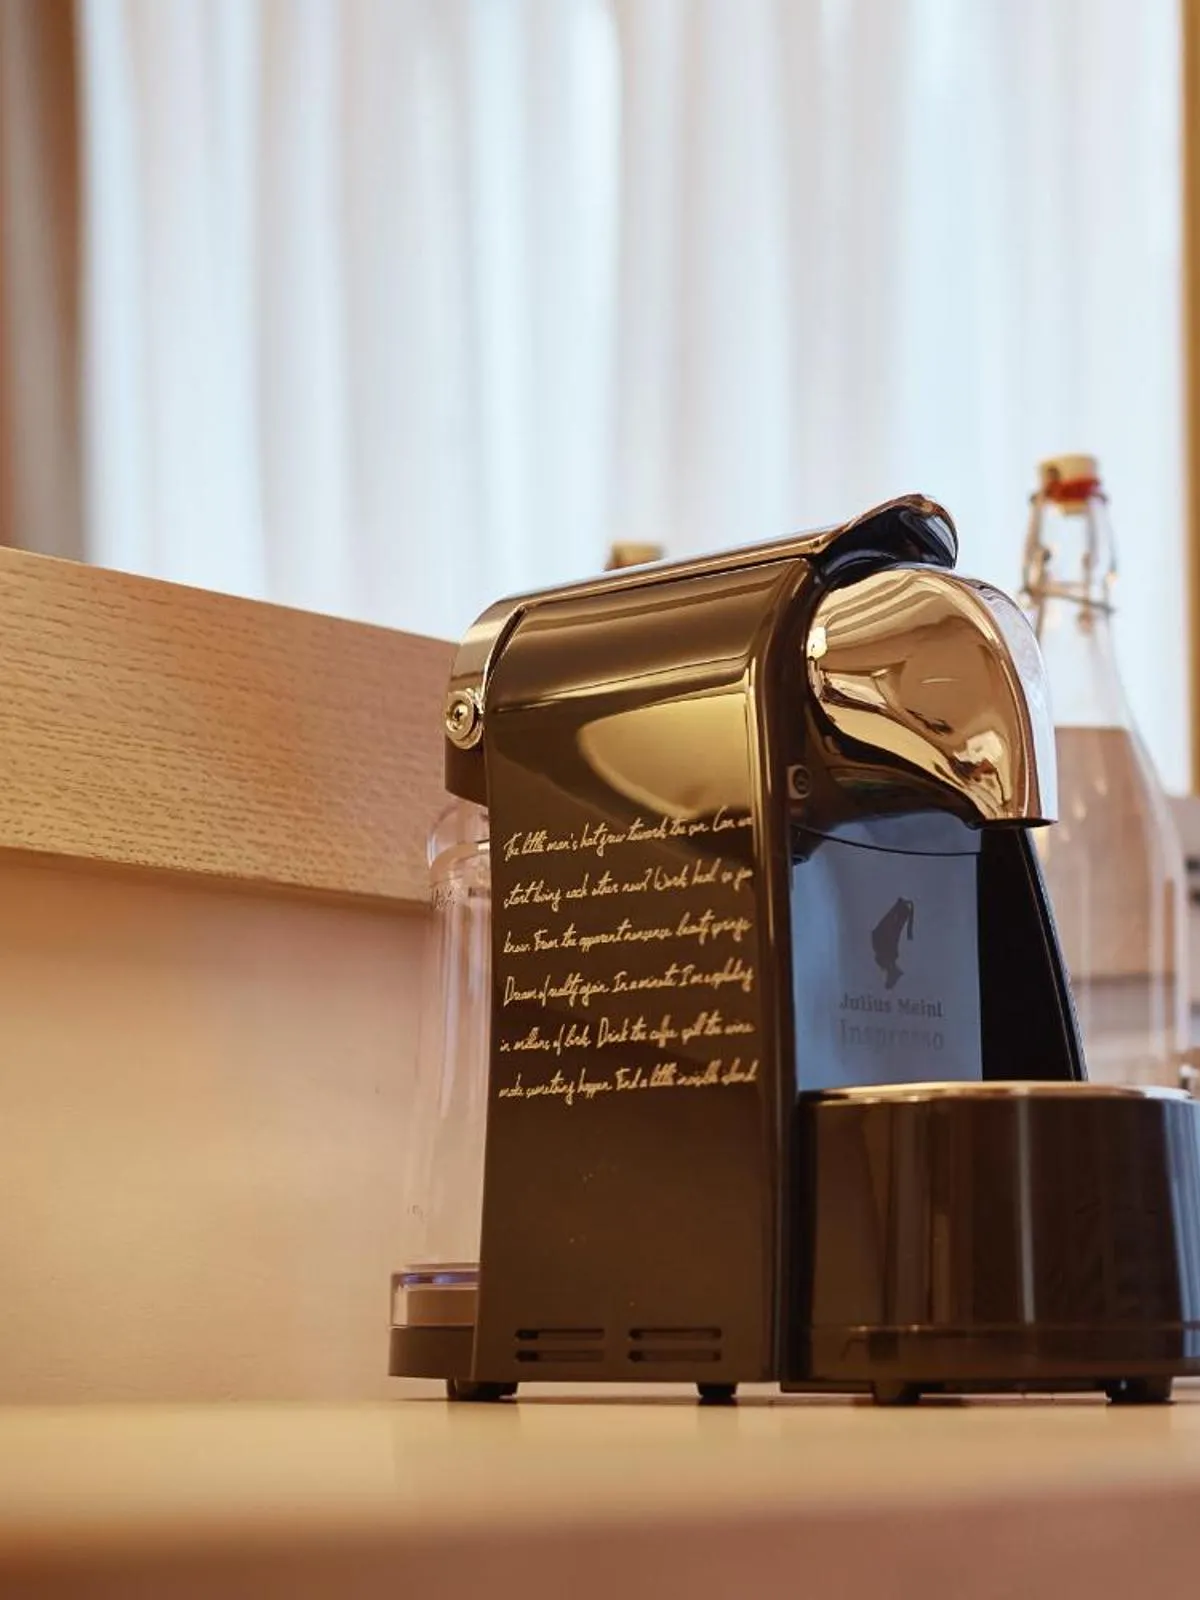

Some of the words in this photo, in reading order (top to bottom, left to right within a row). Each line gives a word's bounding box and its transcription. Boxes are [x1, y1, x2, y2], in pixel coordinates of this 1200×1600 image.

[503, 831, 522, 861] The
[521, 829, 548, 854] little
[546, 832, 578, 852] man's
[712, 805, 736, 832] Can
[591, 870, 619, 896] other
[622, 867, 653, 892] now?
[534, 929, 559, 952] From
[560, 922, 577, 947] the
[503, 975, 537, 1007] Dream
[538, 973, 551, 1007] of
[839, 992, 892, 1013] Julius
[897, 999, 945, 1018] Meinl
[552, 1023, 566, 1056] of
[596, 1016, 629, 1048] Drink
[629, 1015, 647, 1041] the
[526, 1069, 575, 1106] something
[615, 1067, 642, 1091] Find
[649, 1062, 678, 1087] little
